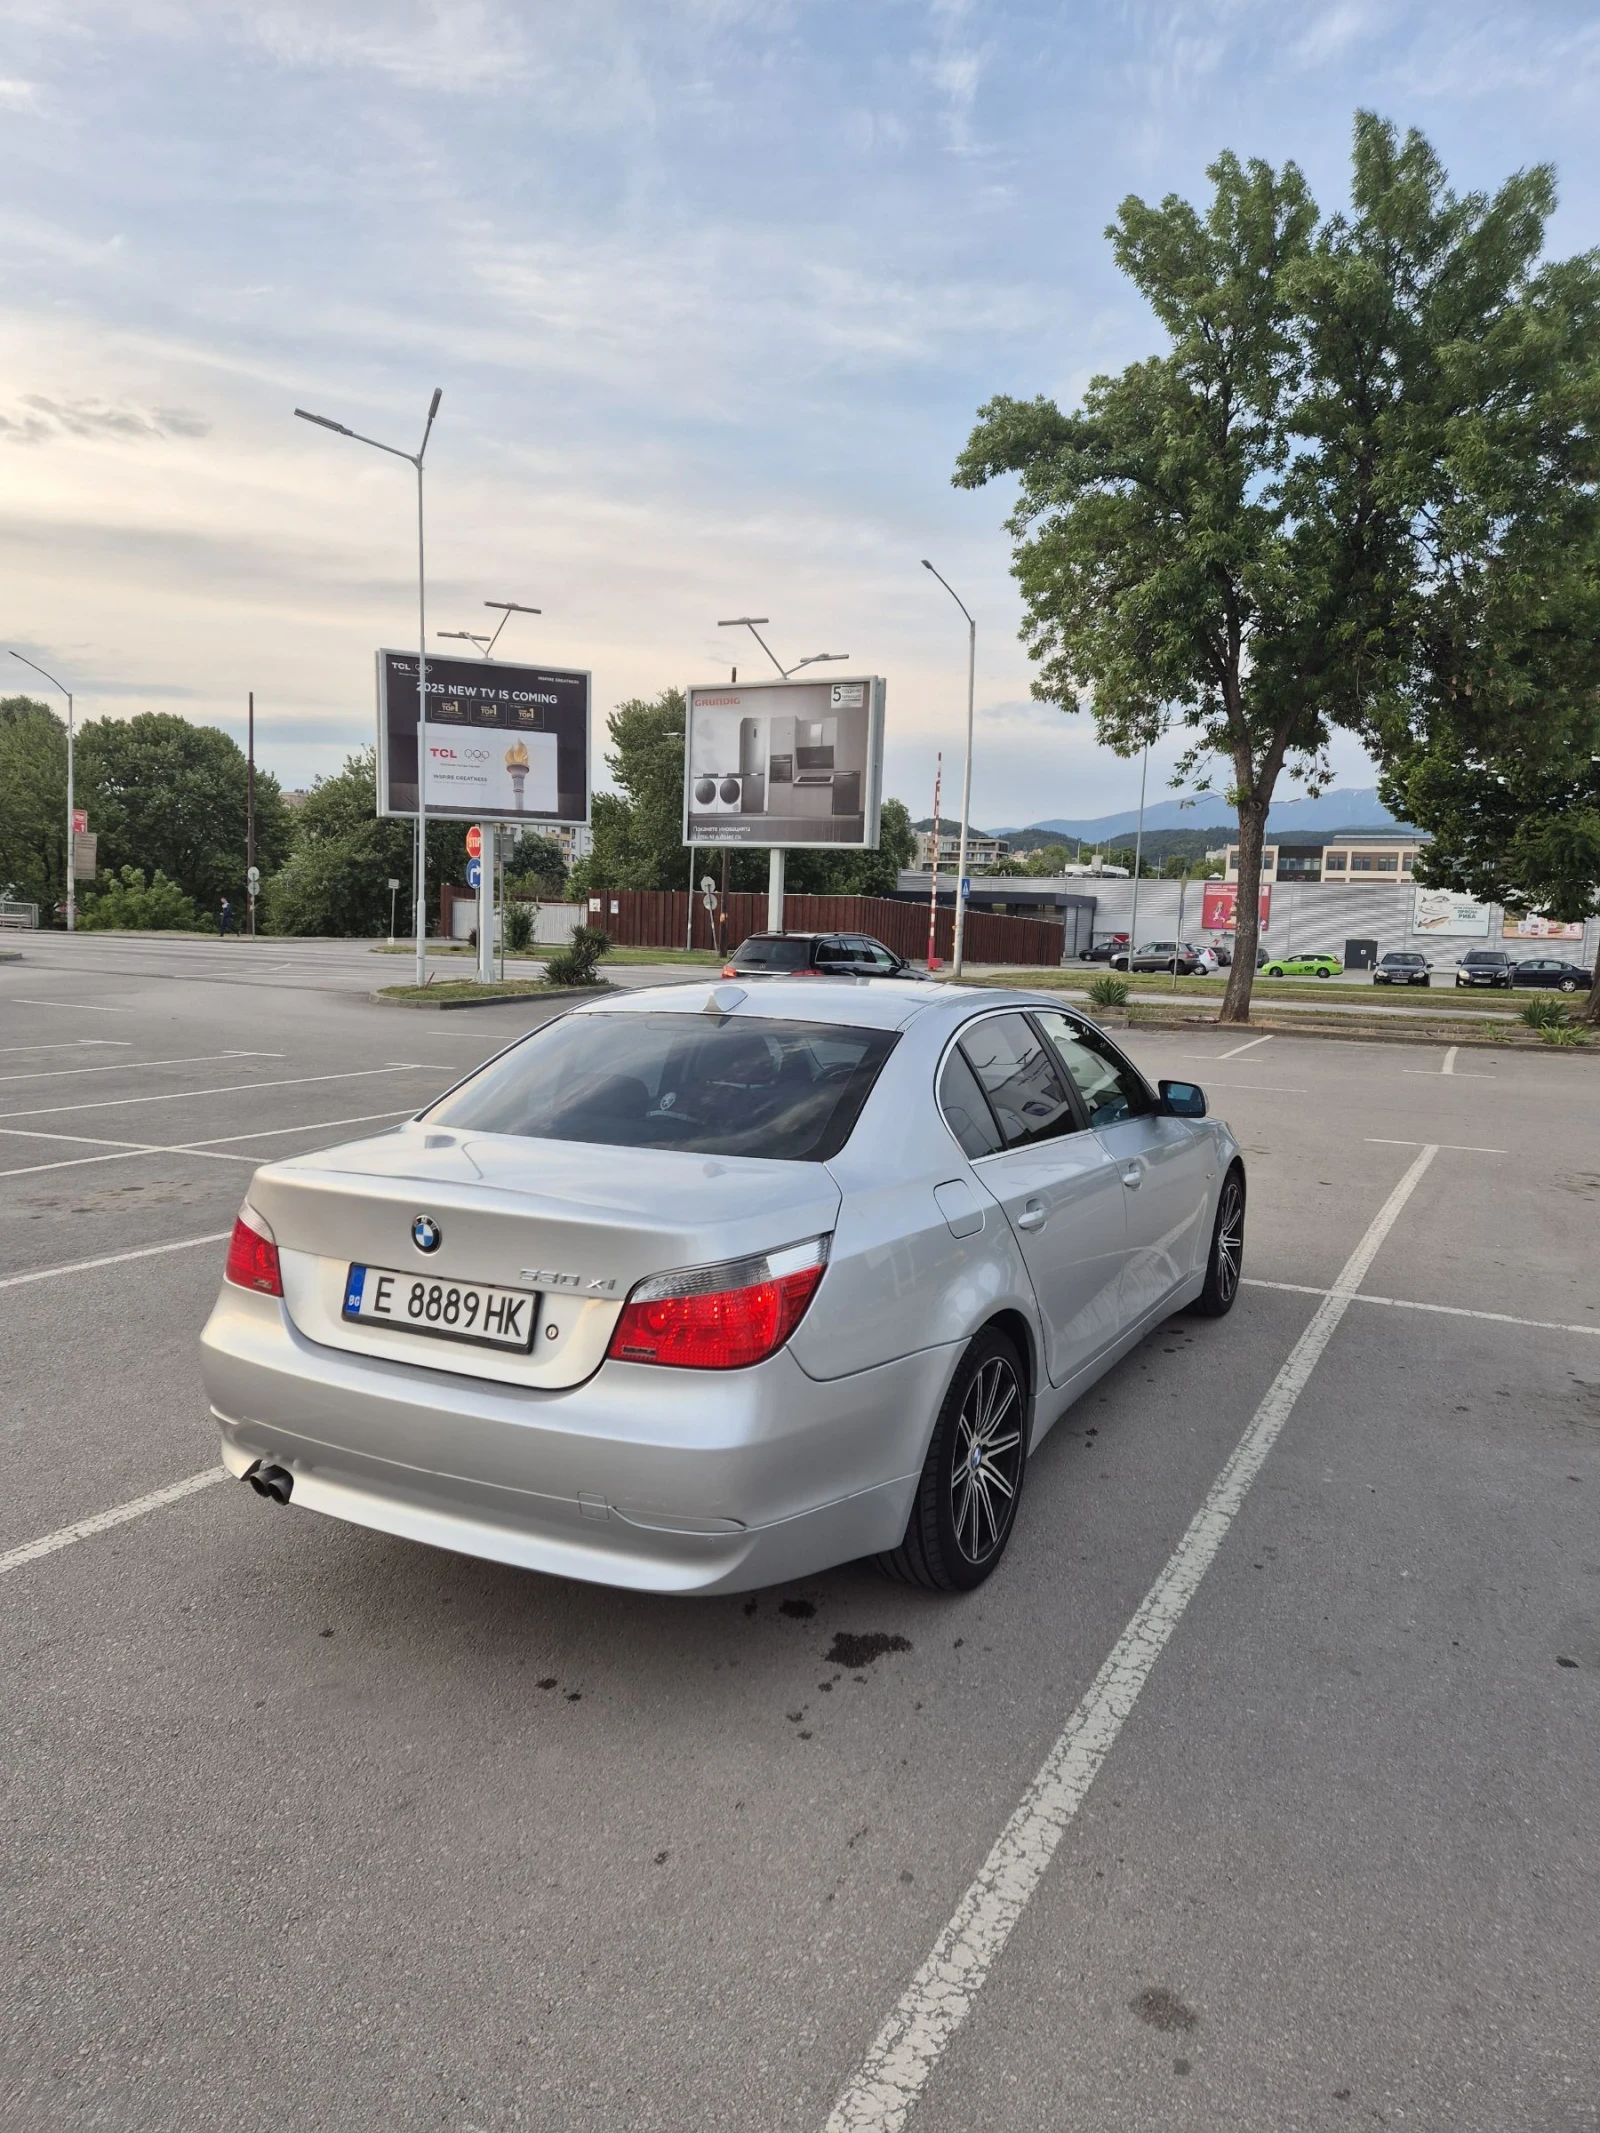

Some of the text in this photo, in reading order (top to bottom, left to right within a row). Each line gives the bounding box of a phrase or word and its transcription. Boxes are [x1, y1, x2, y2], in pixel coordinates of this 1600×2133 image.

[391, 662, 411, 671] TCL
[416, 682, 558, 704] 2025 NEW TV IS COMING
[832, 686, 842, 702] 5
[694, 697, 740, 707] GRUNDIG
[430, 748, 457, 759] TCL
[468, 837, 481, 848] STOP
[520, 1268, 580, 1287] 530
[374, 1276, 395, 1313] E
[348, 1295, 360, 1307] BG
